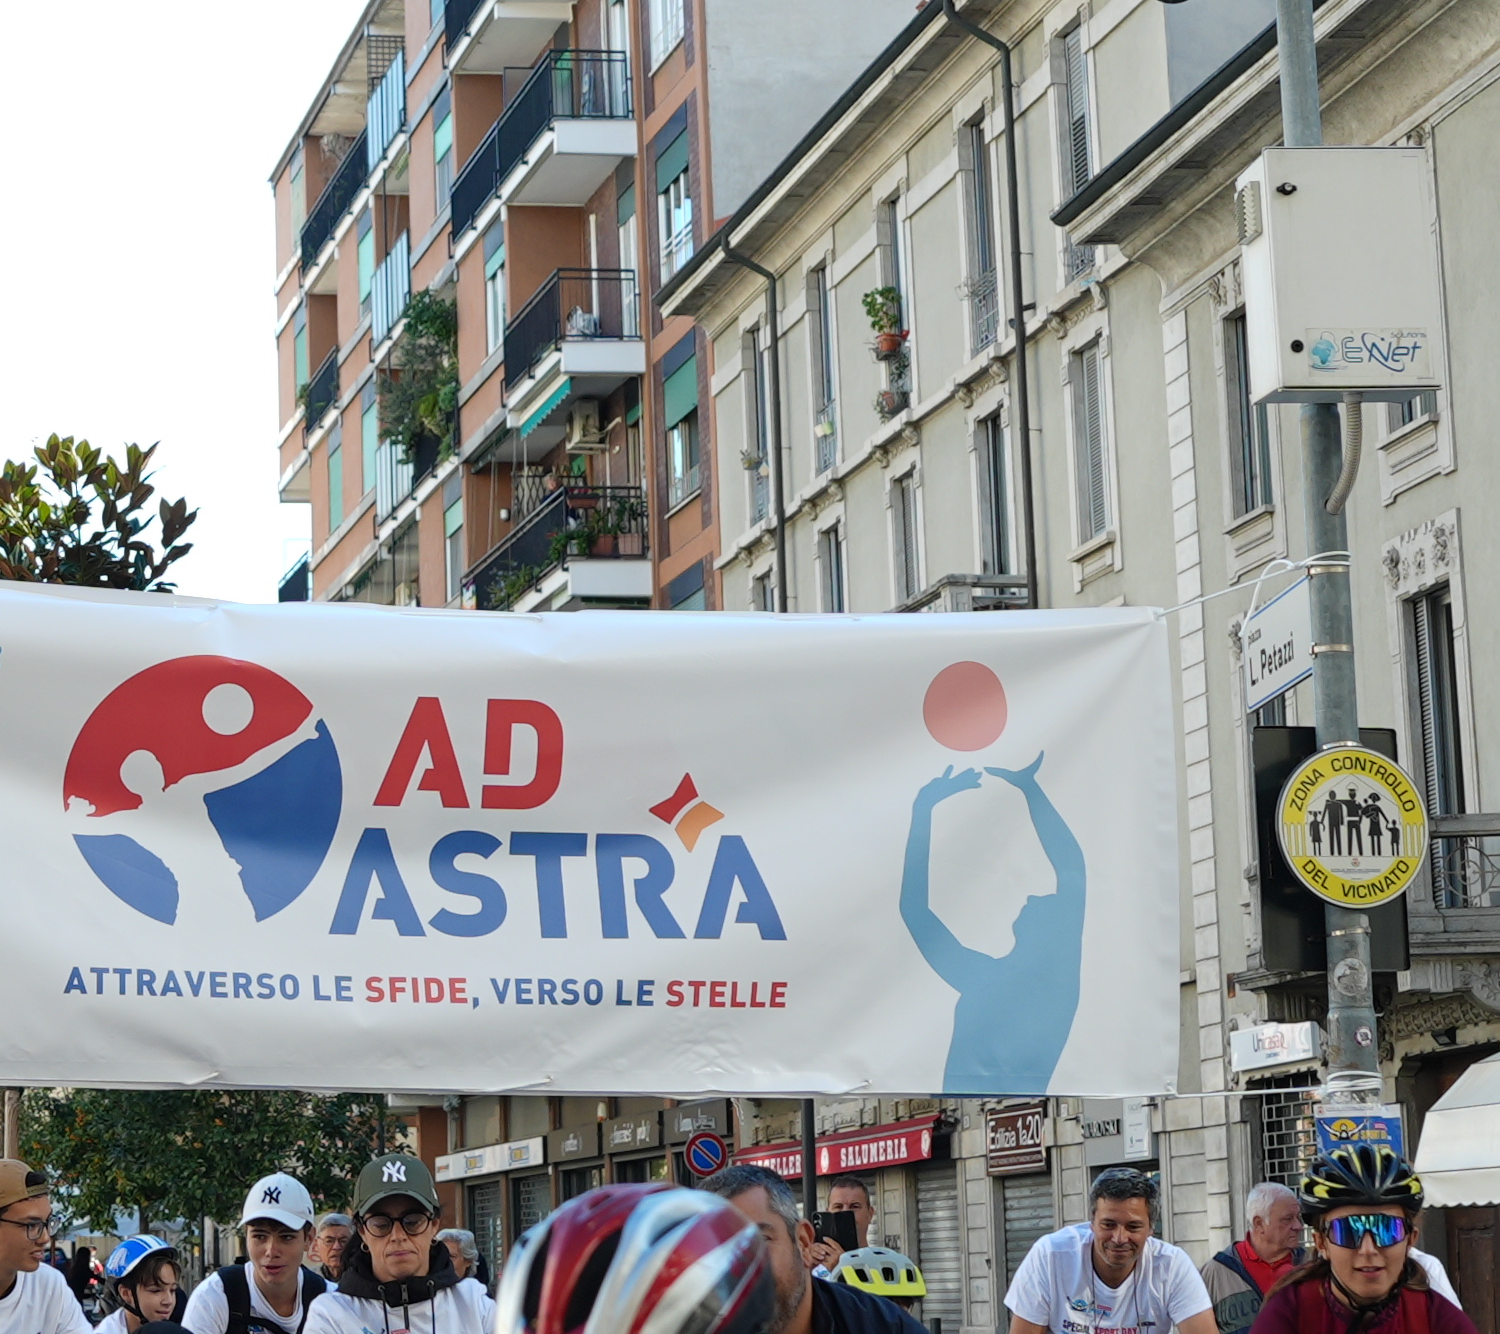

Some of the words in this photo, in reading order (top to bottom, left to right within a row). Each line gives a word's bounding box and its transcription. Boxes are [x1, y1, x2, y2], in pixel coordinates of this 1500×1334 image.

[1249, 657, 1259, 687] L.
[1260, 630, 1295, 680] Petazzi
[371, 696, 565, 810] AD
[1289, 768, 1325, 812] ZONA
[1330, 756, 1416, 813] CONTROLLO
[328, 827, 788, 941] ASTRA
[1302, 859, 1329, 891] DEL
[1341, 859, 1410, 899] VICINATO
[63, 965, 301, 1002] ATTRAVERSO
[313, 974, 354, 1003] LE
[364, 975, 481, 1011] SFIDE,
[490, 977, 604, 1007] VERSO
[616, 979, 655, 1007] LE
[665, 979, 788, 1009] STELLE
[840, 1138, 909, 1168] SALUMERIA
